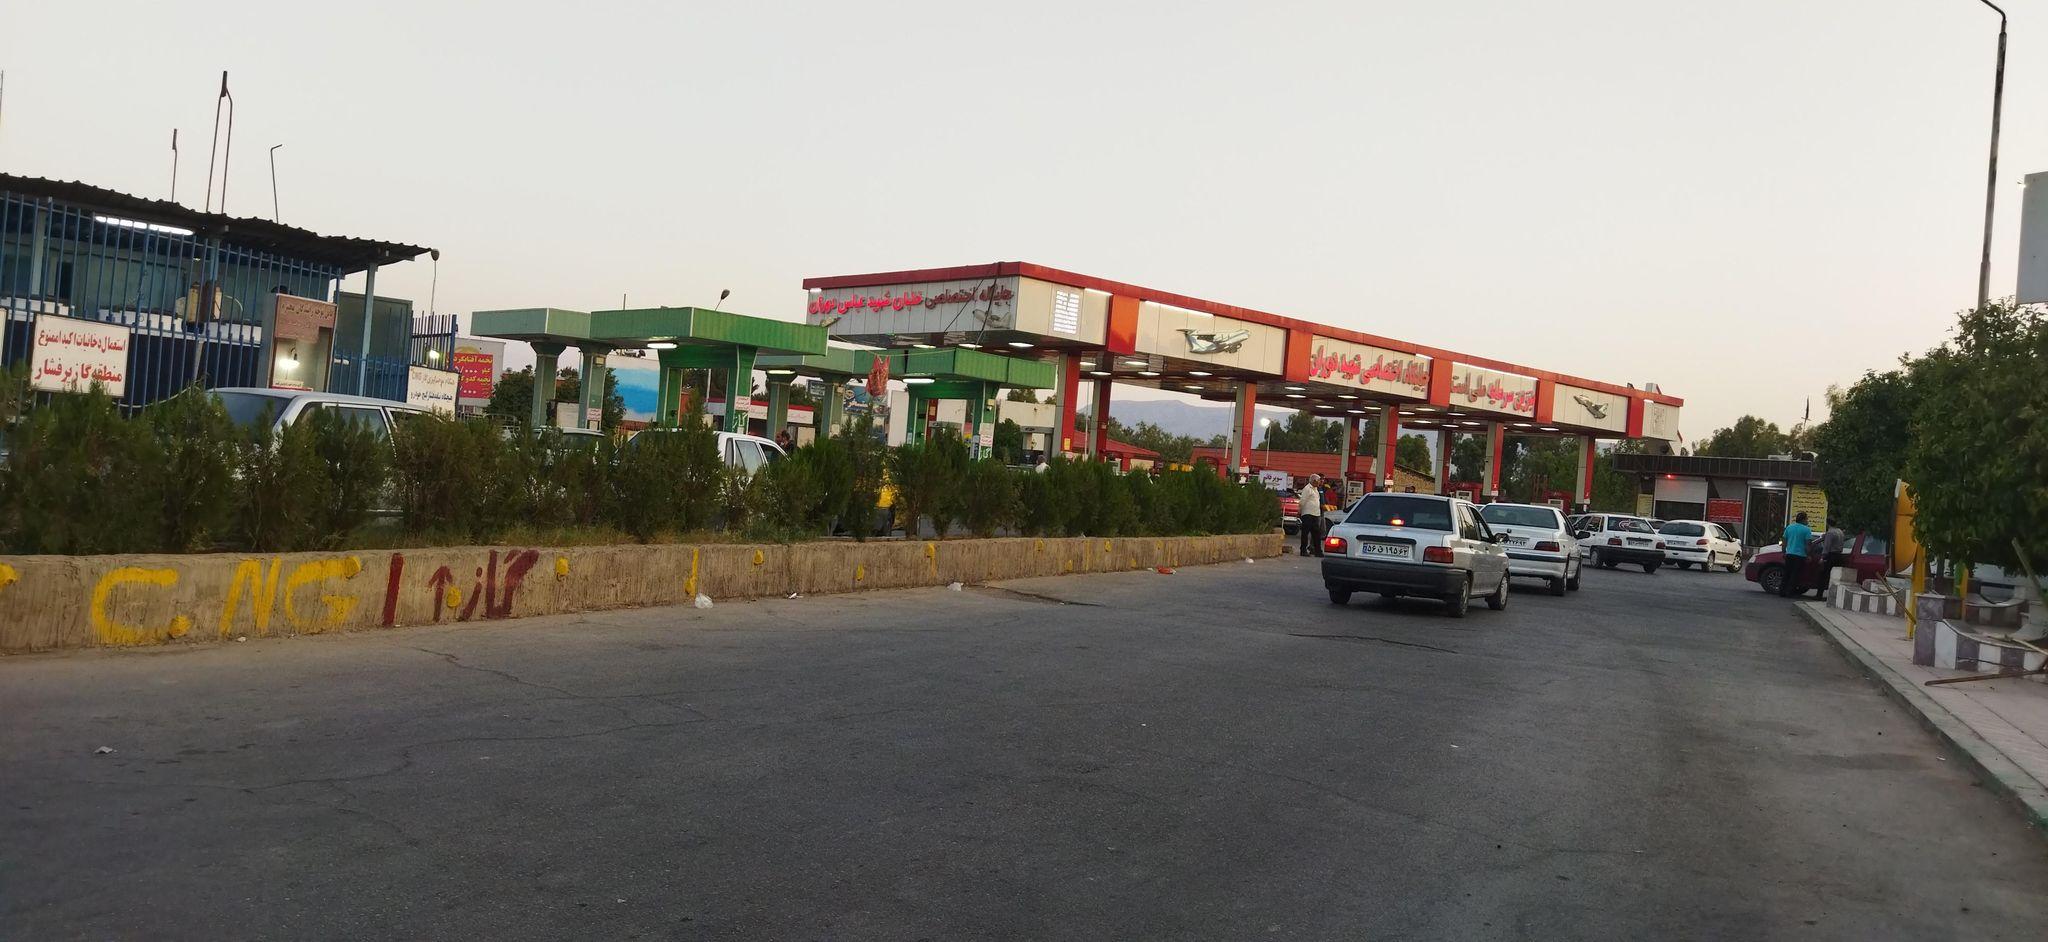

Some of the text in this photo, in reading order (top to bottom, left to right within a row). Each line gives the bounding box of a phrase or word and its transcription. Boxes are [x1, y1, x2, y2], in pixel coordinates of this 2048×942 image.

[809, 284, 1014, 315] جایگاه اختصاصی خلبان شهید عباس دوران
[38, 329, 59, 347] ممنوع
[76, 332, 102, 352] دخانیات
[101, 335, 126, 353] استعمال
[72, 362, 92, 385] گاز
[91, 364, 123, 383] منطقه
[1309, 345, 1430, 393] جایگاه اختصاصی شهید دوران
[1450, 368, 1472, 395] است
[1468, 374, 1487, 403] ملی
[459, 549, 539, 622] گاز
